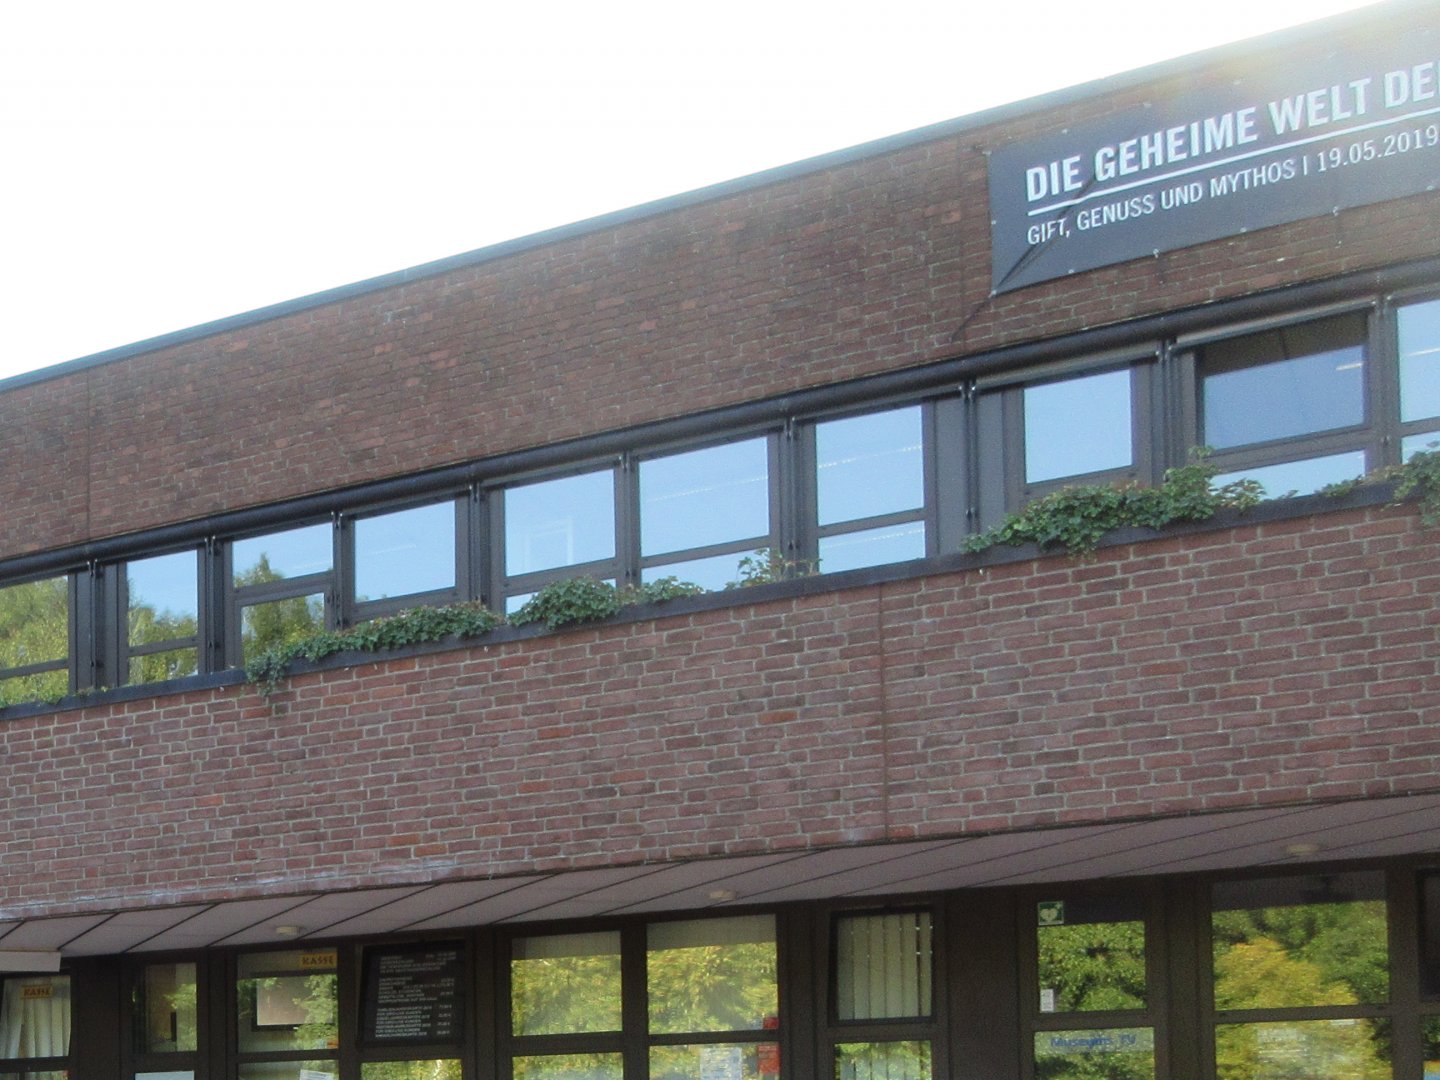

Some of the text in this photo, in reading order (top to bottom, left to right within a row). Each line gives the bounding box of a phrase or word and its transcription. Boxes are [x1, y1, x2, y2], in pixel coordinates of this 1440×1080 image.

[1026, 60, 1440, 202] DIE GEHEIME WELT DE
[1027, 217, 1071, 245] GIFT,
[1076, 194, 1155, 231] GENUSS
[1160, 182, 1203, 210] UND
[1210, 159, 1295, 198] MYTHOS
[1317, 124, 1438, 172] 19.05.2019
